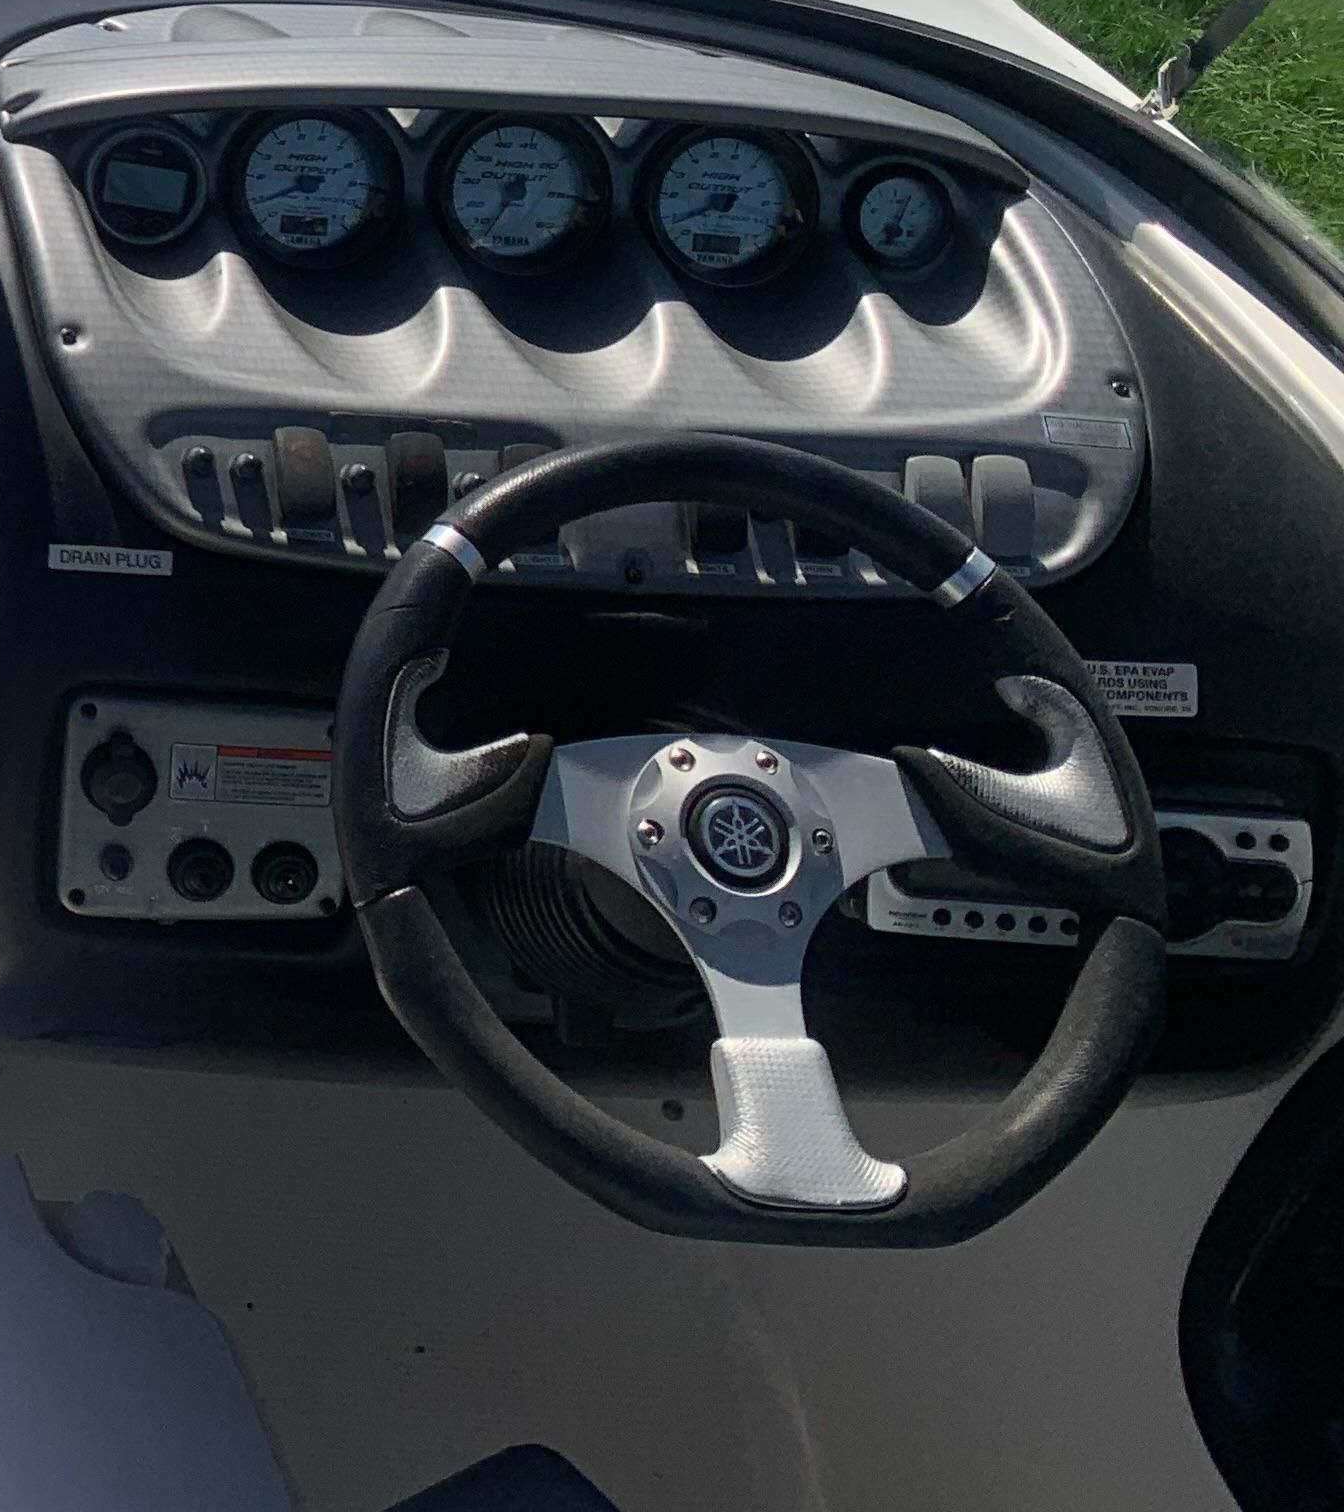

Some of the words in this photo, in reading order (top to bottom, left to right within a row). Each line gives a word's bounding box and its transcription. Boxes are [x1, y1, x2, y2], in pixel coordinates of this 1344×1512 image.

[60, 550, 111, 566] DRAIN
[115, 552, 162, 569] PLUG
[1114, 665, 1140, 676] EPA
[1142, 666, 1176, 677] EVAP
[1127, 678, 1168, 690] USING
[1105, 690, 1189, 702] OMPONENTS
